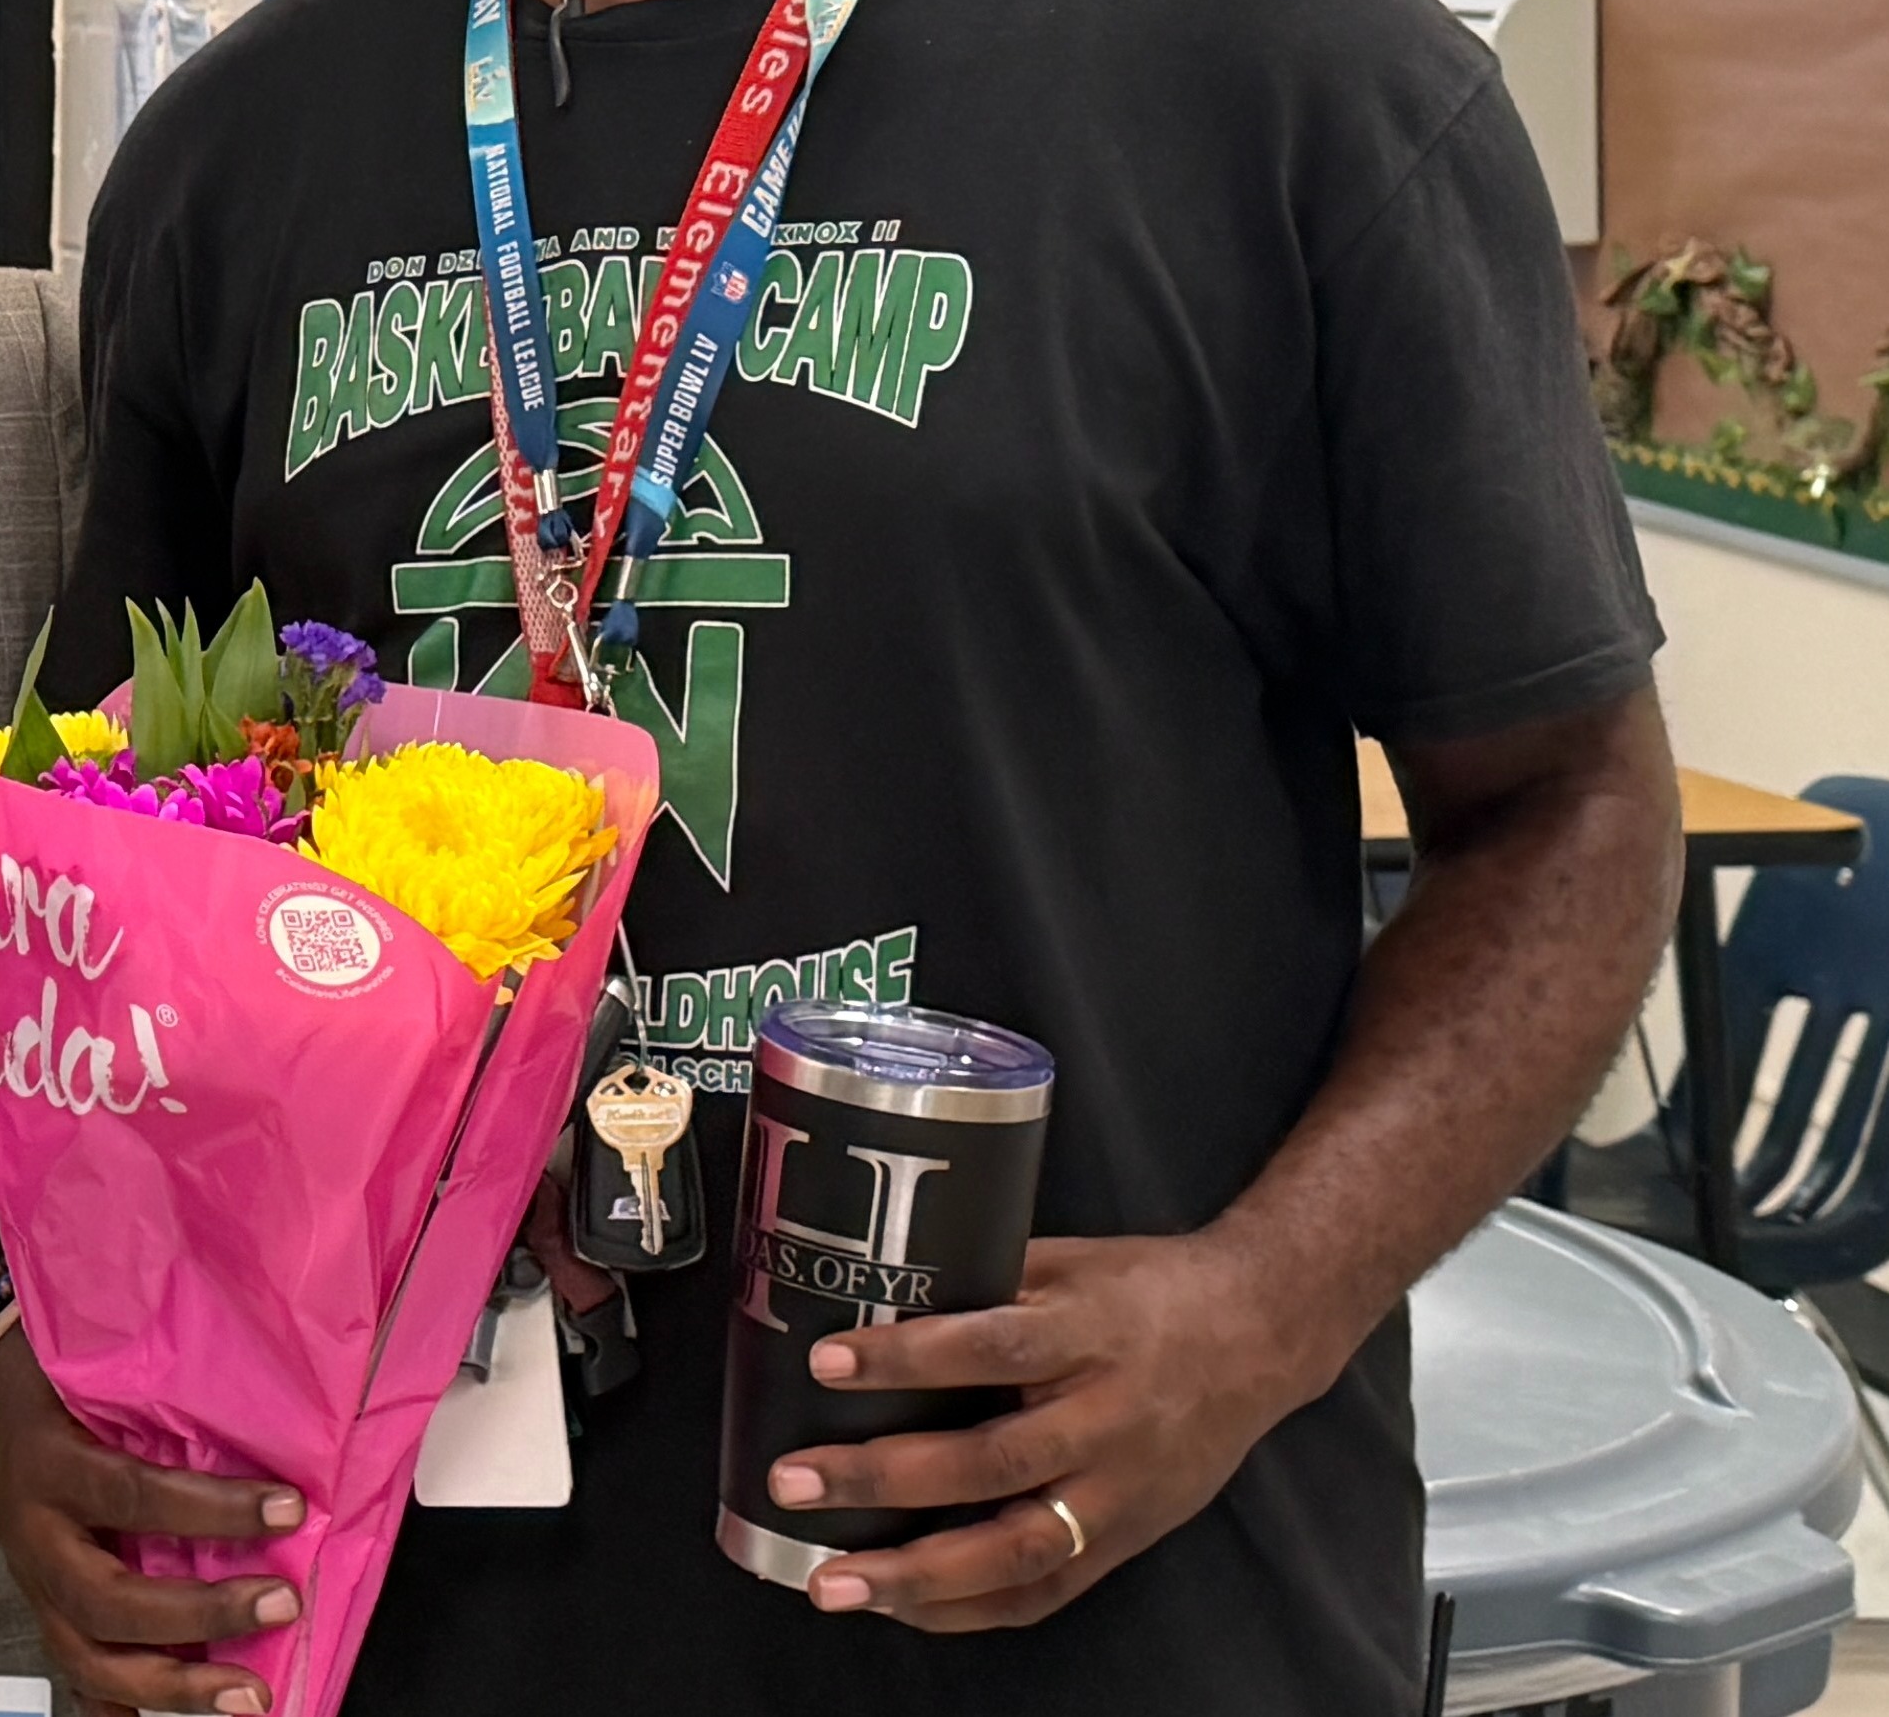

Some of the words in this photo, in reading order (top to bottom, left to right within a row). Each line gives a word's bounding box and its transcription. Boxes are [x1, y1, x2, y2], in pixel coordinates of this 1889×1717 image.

[485, 143, 516, 235] NATIONAL
[741, 137, 793, 237] GAME
[367, 256, 425, 283] DON
[570, 227, 639, 252] AND
[772, 222, 864, 247] KNOX
[871, 220, 901, 242] II
[497, 240, 531, 335] FOOTBALL
[512, 338, 546, 412] LEAGUE
[737, 249, 972, 428] CAMP
[650, 419, 688, 490] SUPER
[669, 362, 709, 422] BOWL
[690, 333, 718, 363] LV
[813, 1255, 871, 1295] OF
[876, 1269, 934, 1306] YR
